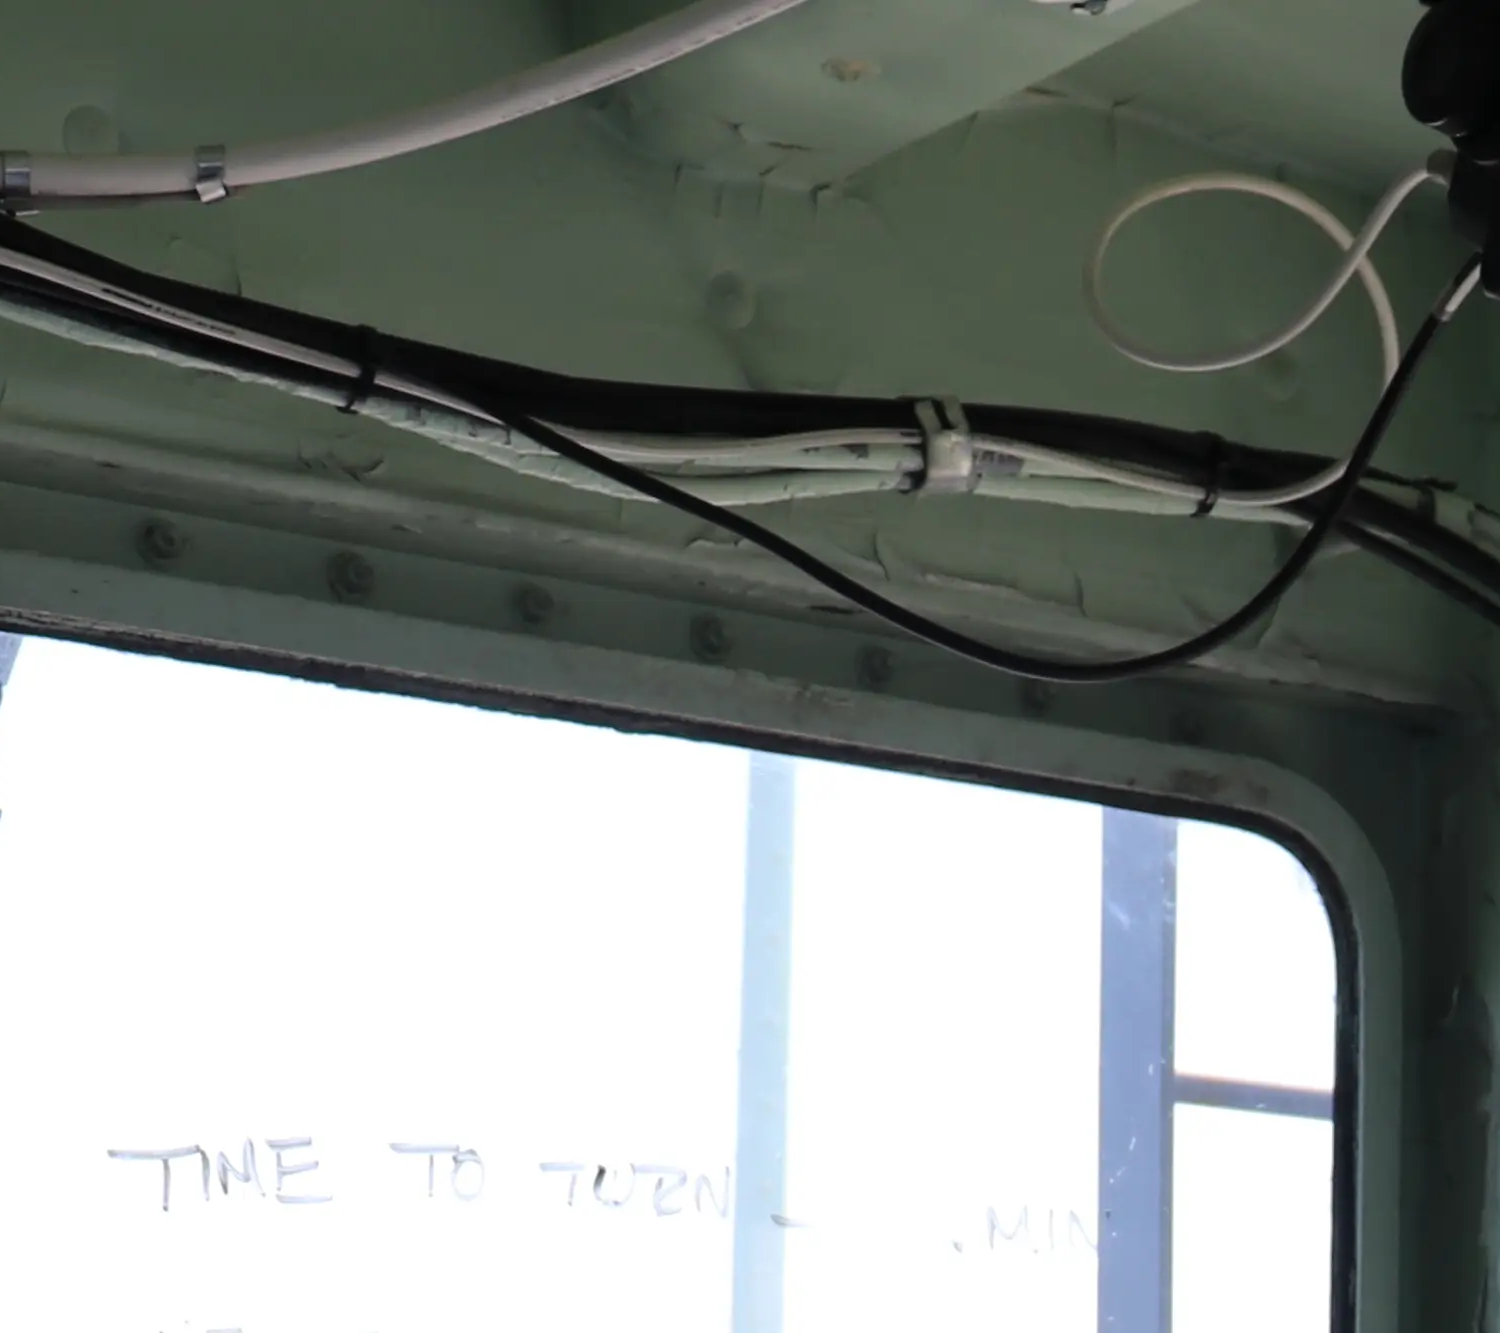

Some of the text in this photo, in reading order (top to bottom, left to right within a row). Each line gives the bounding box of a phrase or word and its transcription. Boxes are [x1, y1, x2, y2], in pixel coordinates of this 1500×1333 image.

[107, 1136, 334, 1212] TIME
[389, 1142, 487, 1206] TO
[538, 1161, 732, 1219] TURN
